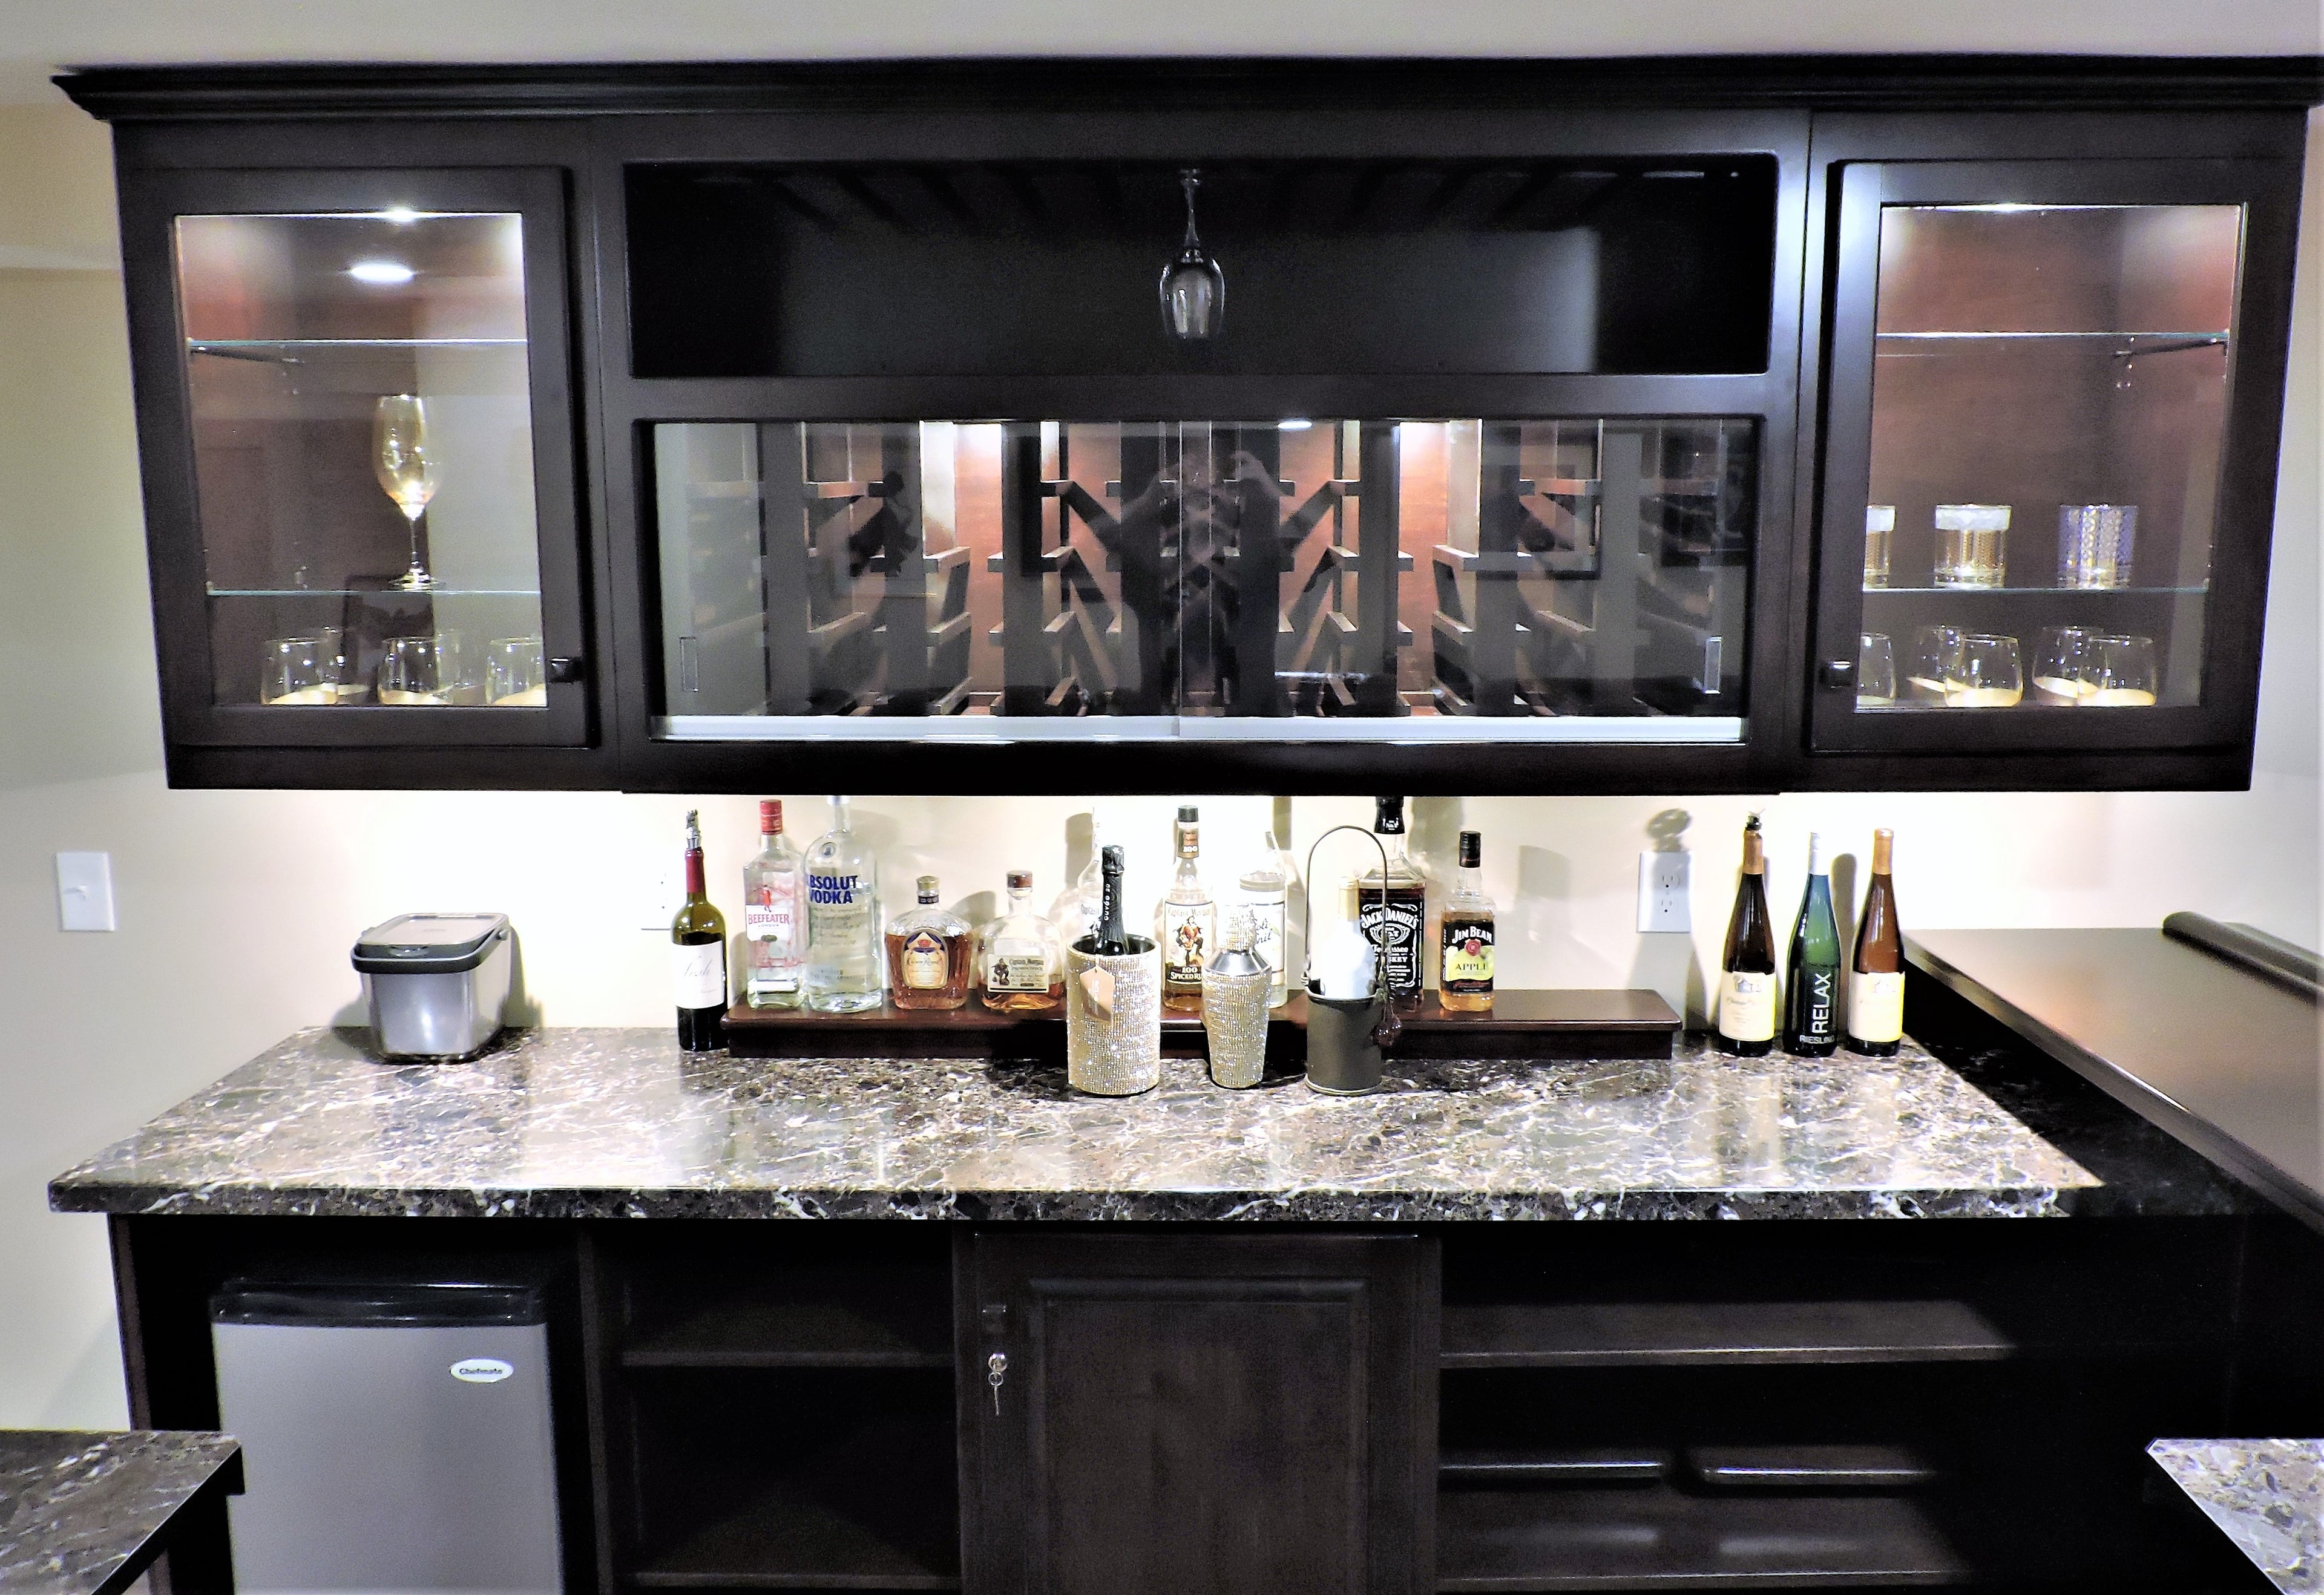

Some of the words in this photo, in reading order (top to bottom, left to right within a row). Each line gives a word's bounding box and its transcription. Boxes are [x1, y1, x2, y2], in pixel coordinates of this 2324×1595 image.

[810, 875, 858, 890] BSOLUT
[748, 914, 789, 925] BEEFEATER
[1452, 929, 1469, 944] JIM
[1469, 926, 1492, 943] BEAM
[1811, 973, 1831, 1033] RELAX
